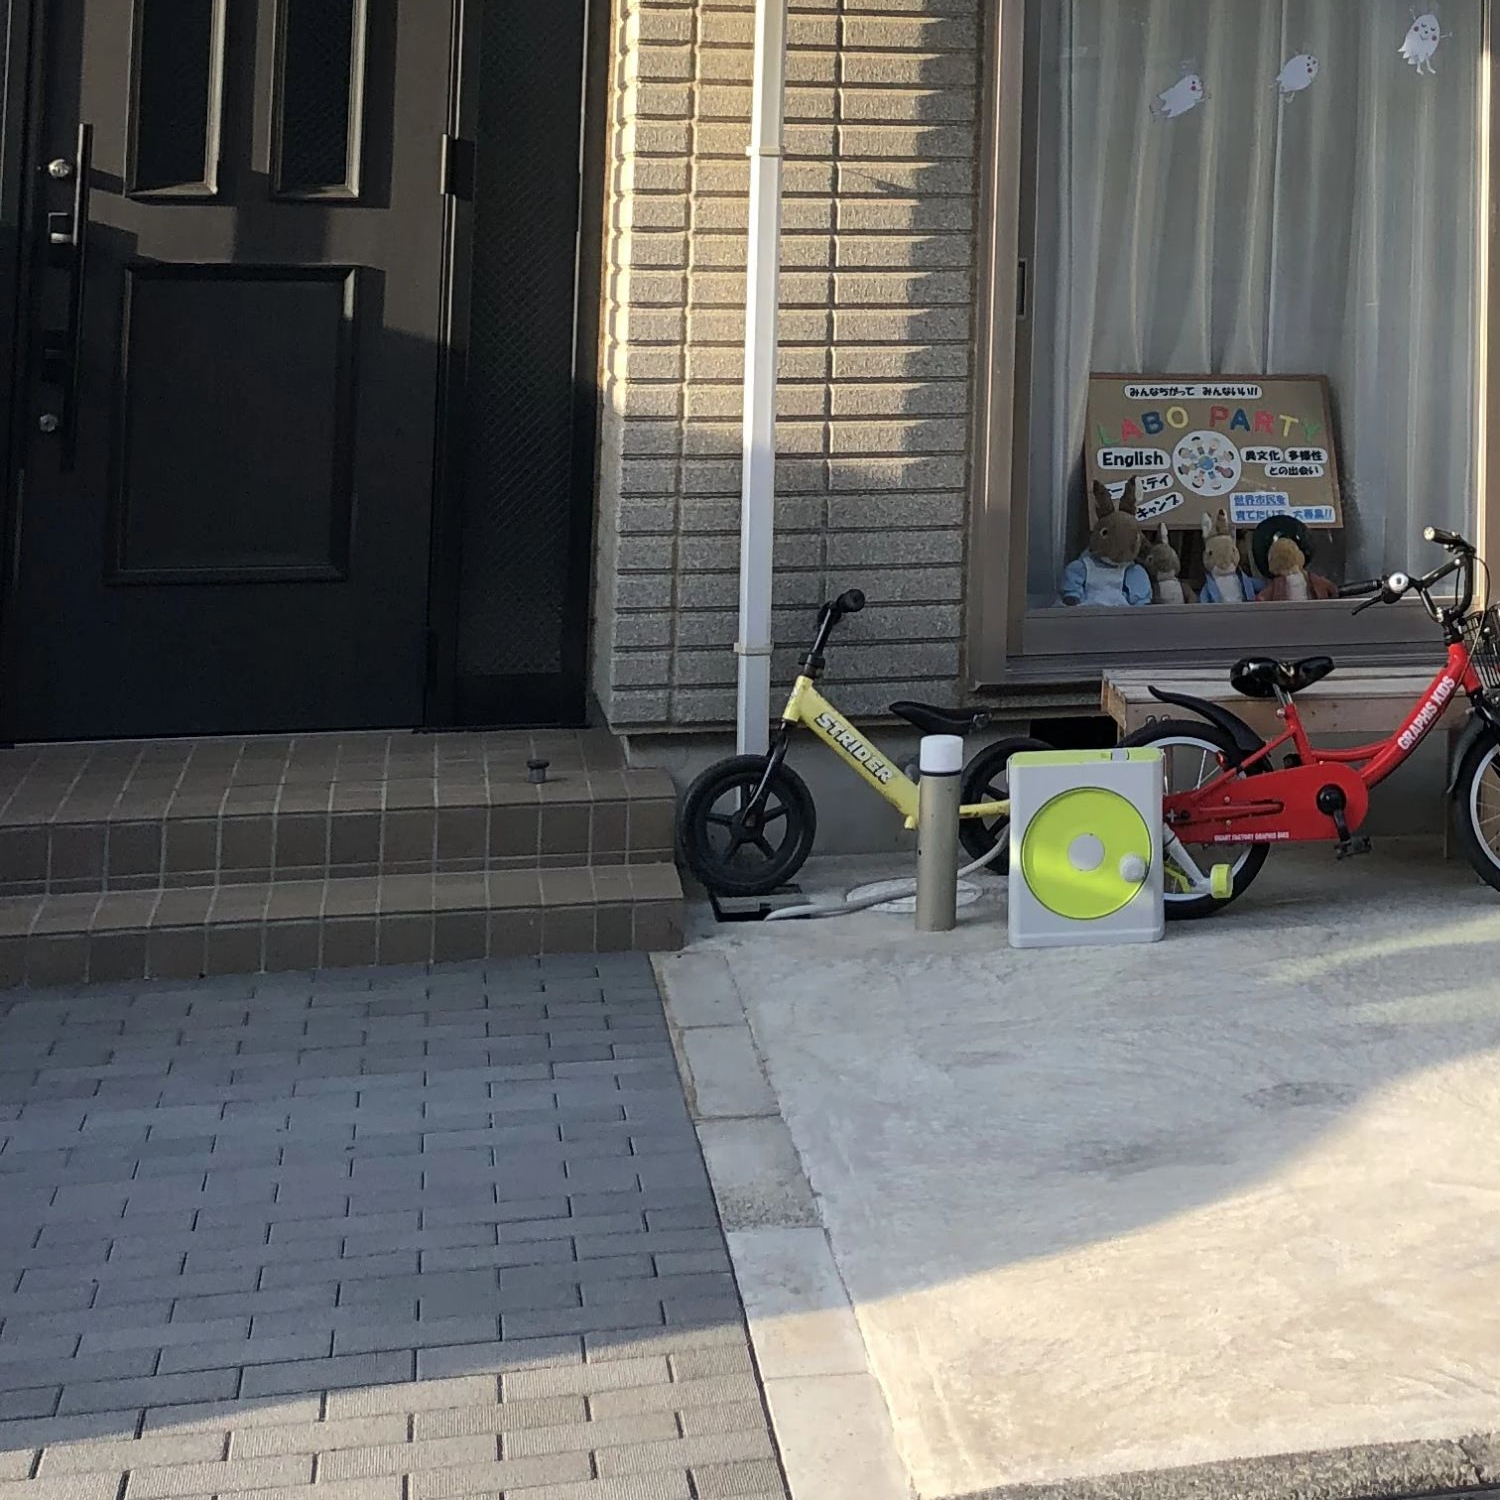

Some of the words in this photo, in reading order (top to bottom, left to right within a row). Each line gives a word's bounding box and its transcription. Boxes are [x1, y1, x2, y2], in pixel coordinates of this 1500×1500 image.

[1129, 387, 1195, 397] みんなちがって
[1096, 405, 1189, 446] LABO
[1209, 404, 1321, 442] PARTY
[1102, 452, 1164, 468] English
[1245, 450, 1281, 461] 異文化
[1288, 450, 1323, 461] 多様性
[1269, 466, 1319, 476] との出会い
[1397, 701, 1438, 750] GRAPHIS
[1430, 675, 1455, 706] KIDS
[814, 712, 893, 785] STRIDER
